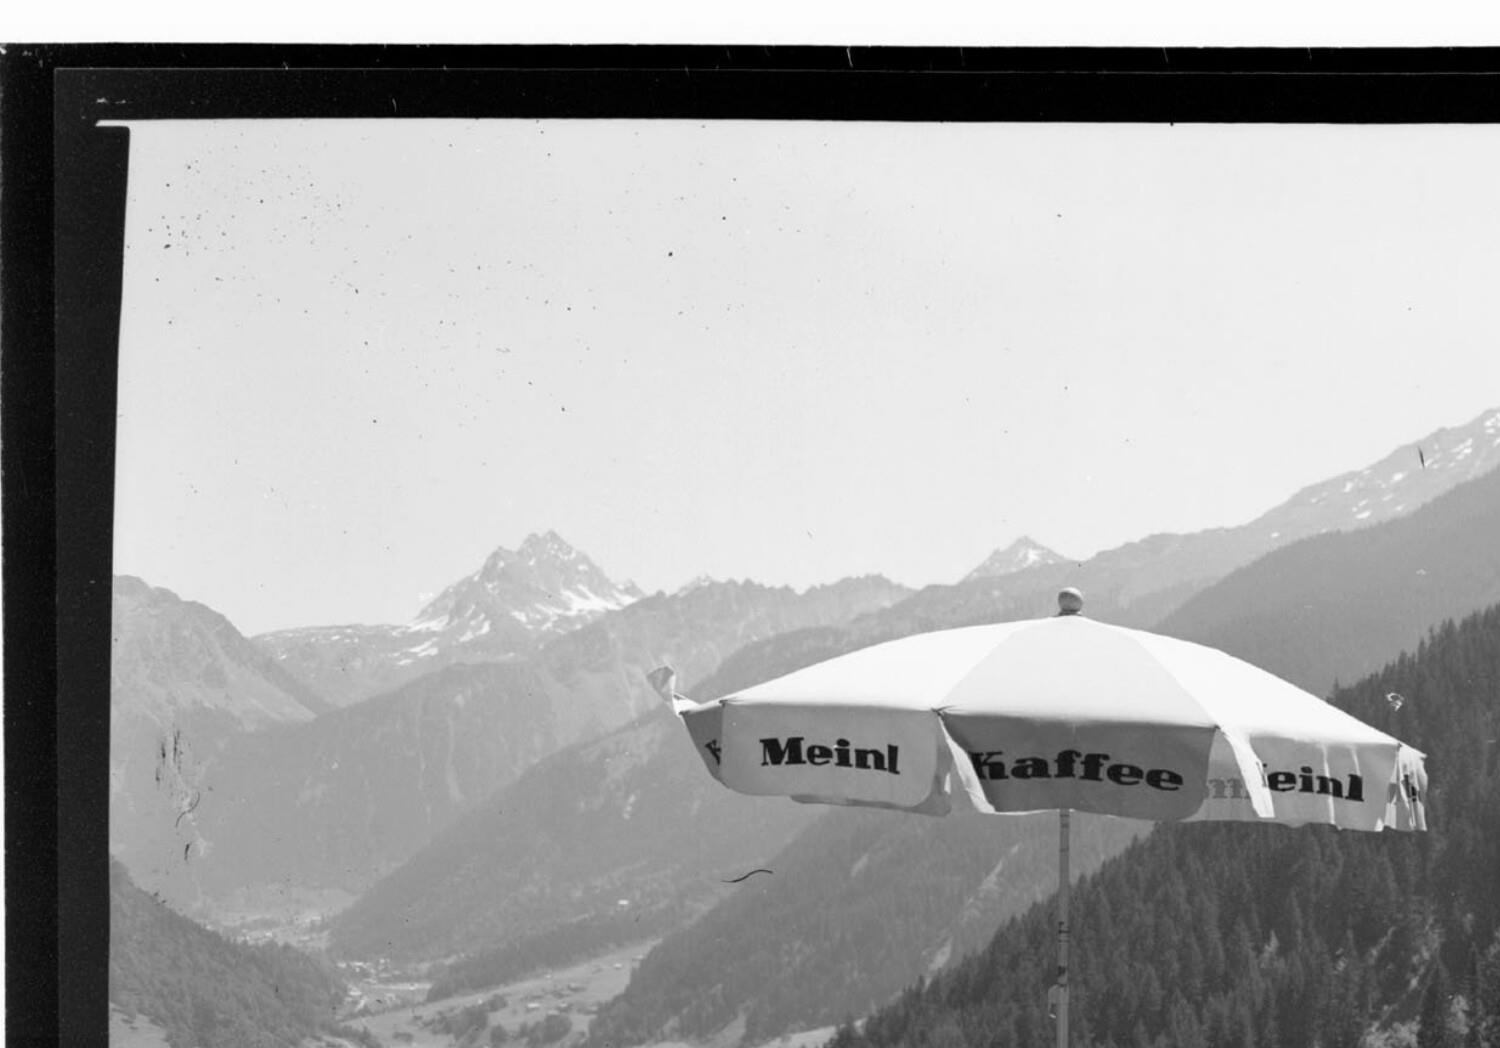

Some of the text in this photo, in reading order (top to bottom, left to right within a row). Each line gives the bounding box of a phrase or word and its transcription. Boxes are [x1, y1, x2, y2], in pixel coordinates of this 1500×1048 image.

[759, 737, 900, 775] Meinl
[969, 749, 1185, 791] Kaffee
[1257, 765, 1365, 802] einl
